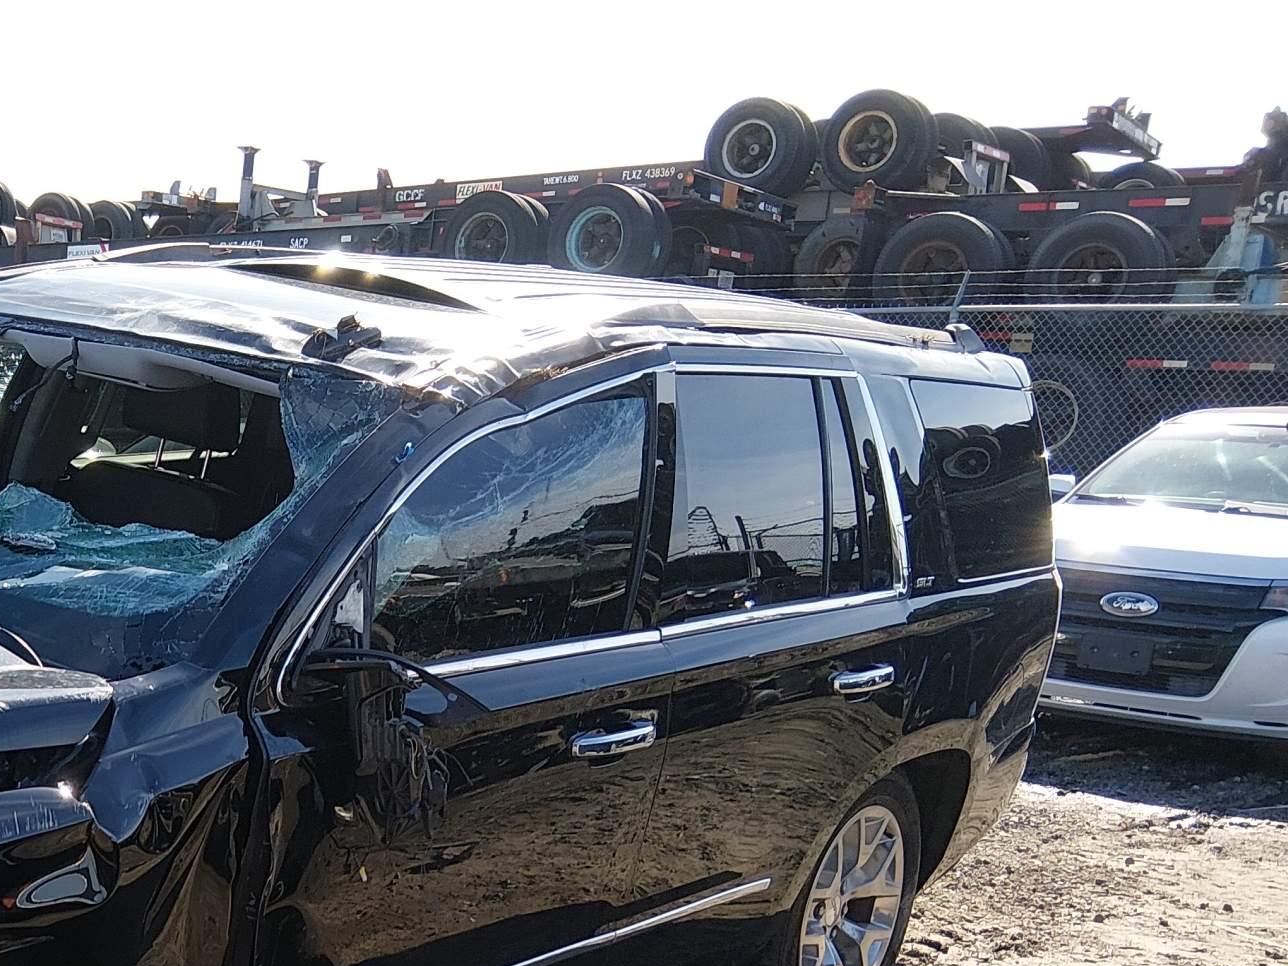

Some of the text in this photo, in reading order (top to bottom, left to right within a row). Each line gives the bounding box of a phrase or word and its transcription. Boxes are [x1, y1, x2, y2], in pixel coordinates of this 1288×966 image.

[622, 166, 676, 181] FLXZ 438369
[289, 237, 309, 249] SACP
